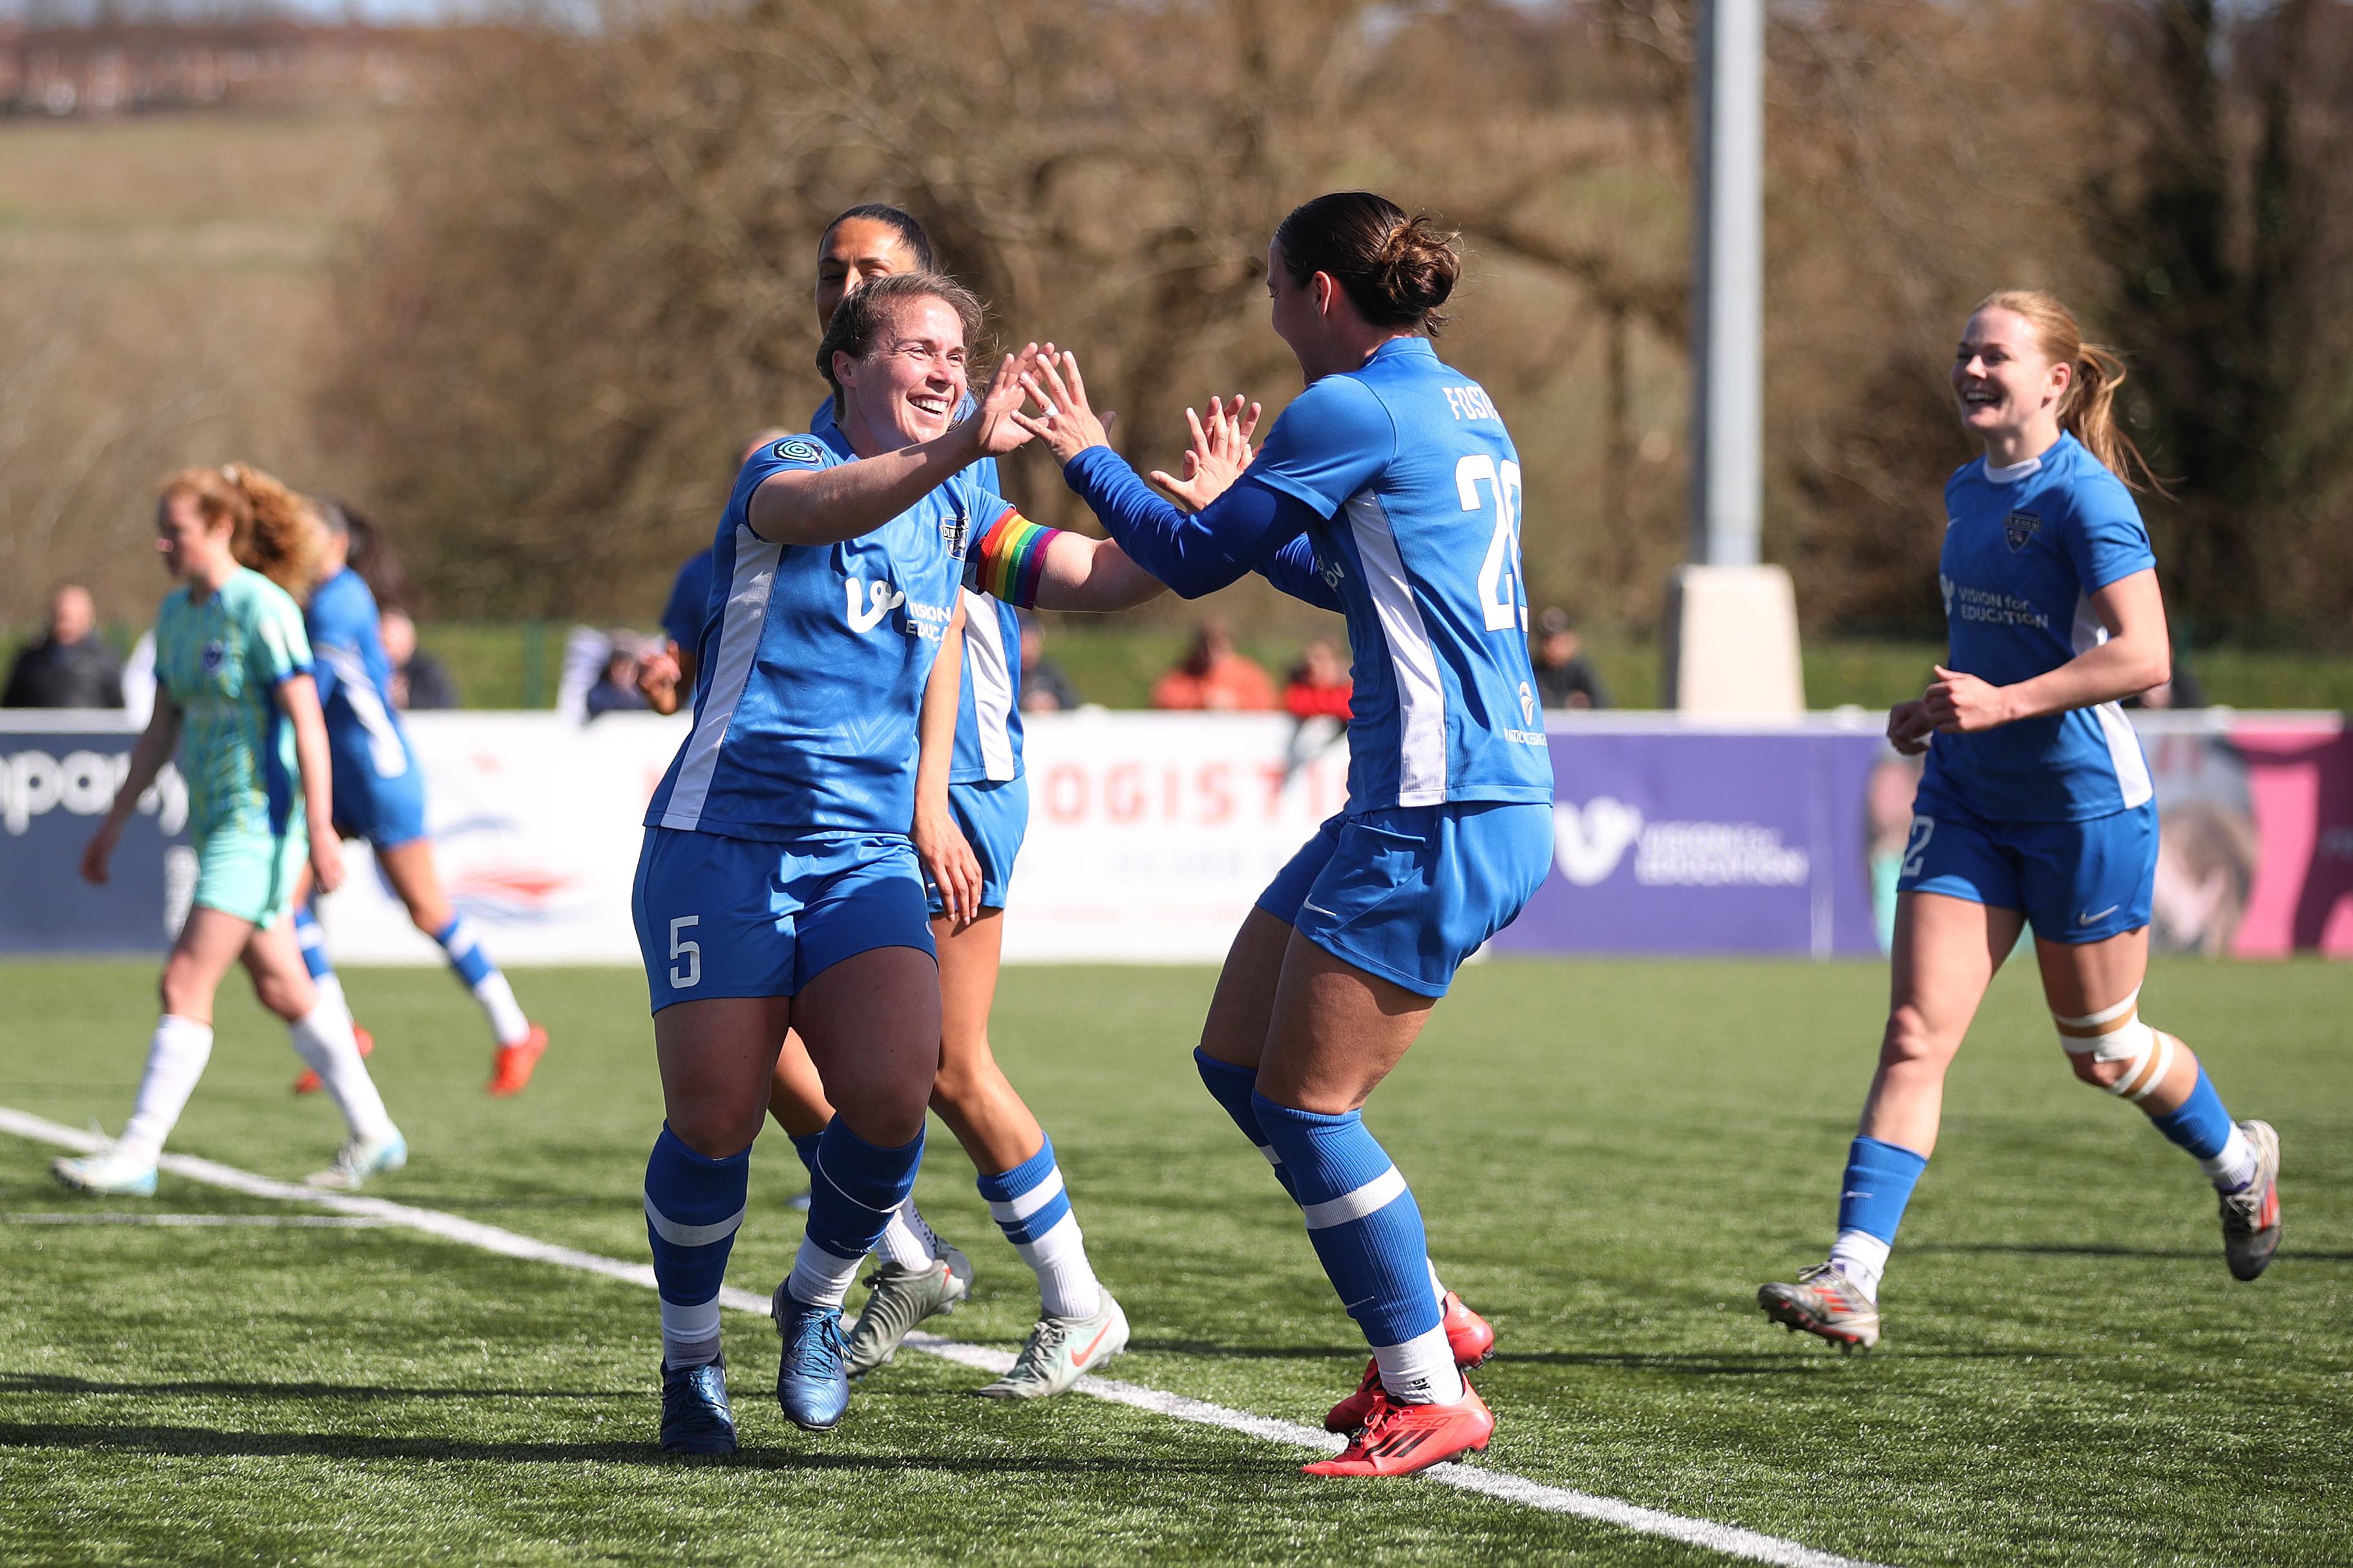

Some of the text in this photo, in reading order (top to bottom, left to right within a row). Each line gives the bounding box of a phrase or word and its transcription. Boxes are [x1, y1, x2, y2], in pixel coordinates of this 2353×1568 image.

[943, 527, 960, 539] DUR
[1958, 587, 2029, 611] VISION for
[1040, 760, 1349, 827] OGISTI
[670, 914, 701, 989] 5
[1395, 1416, 1452, 1428] F50
